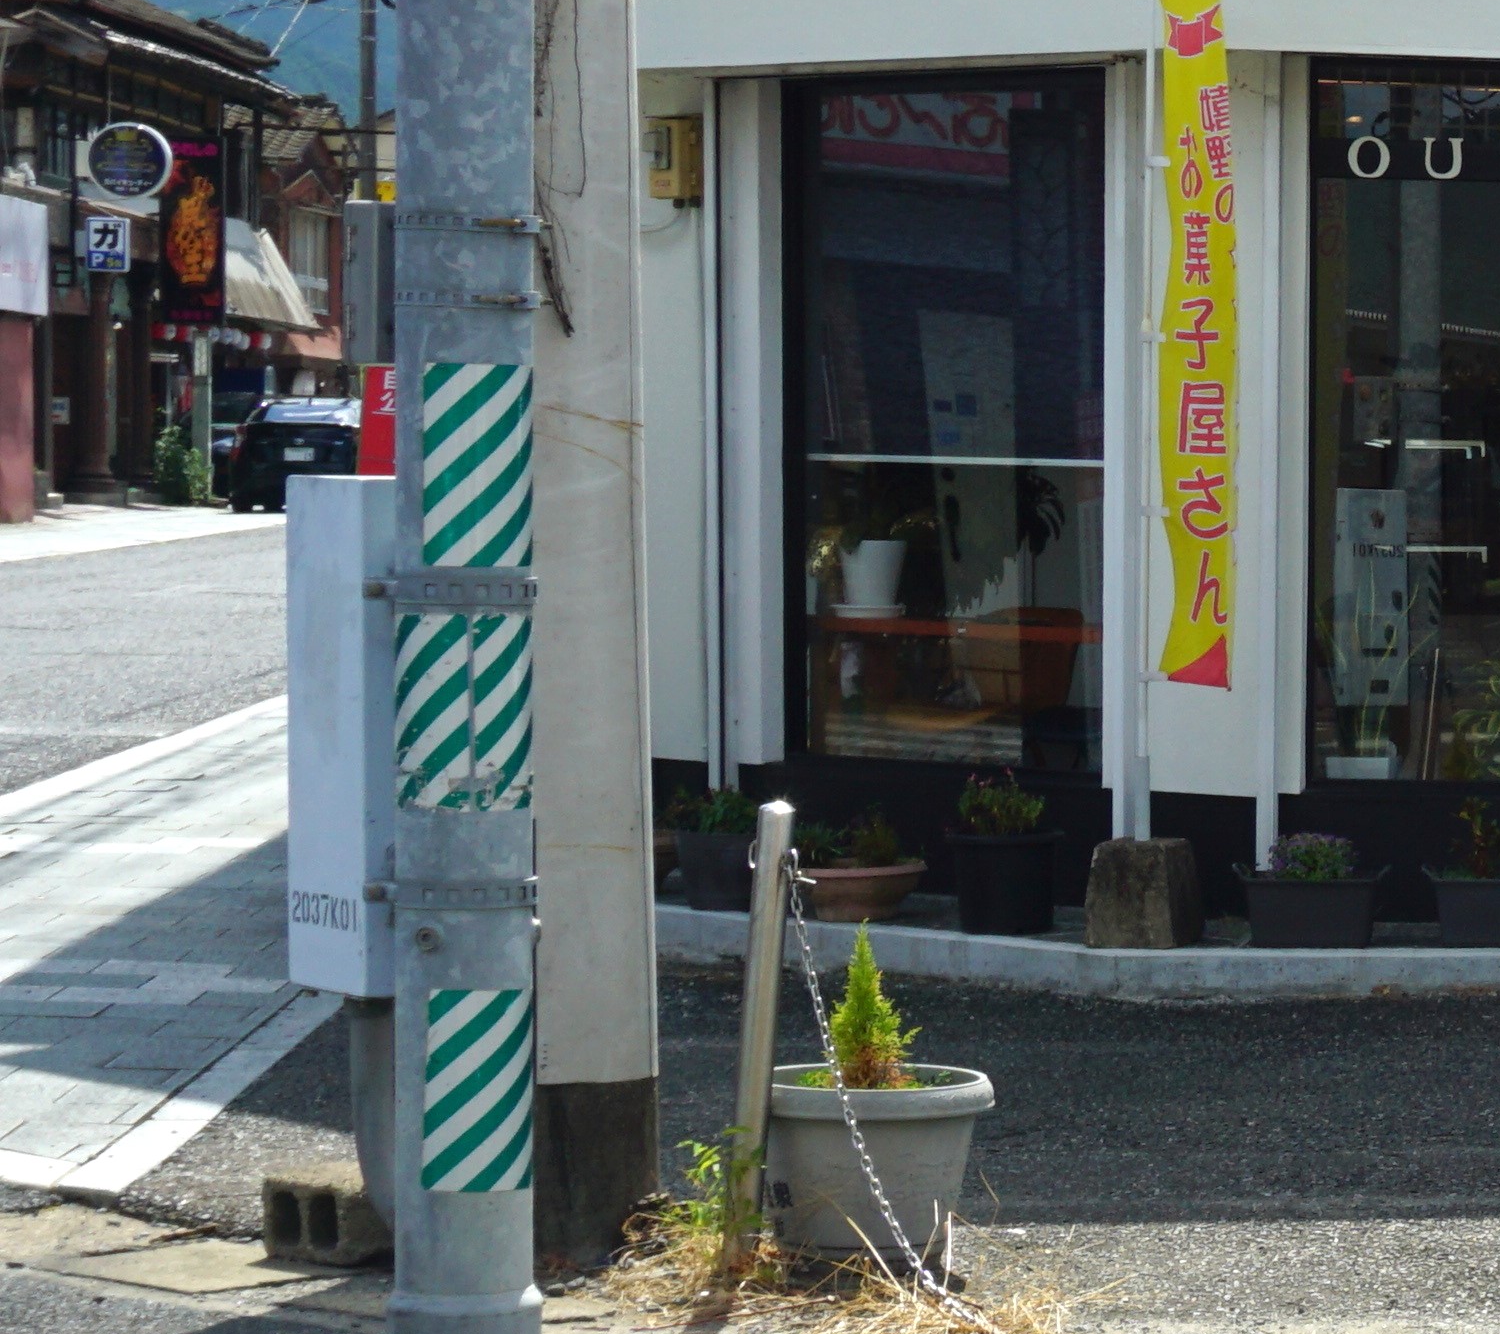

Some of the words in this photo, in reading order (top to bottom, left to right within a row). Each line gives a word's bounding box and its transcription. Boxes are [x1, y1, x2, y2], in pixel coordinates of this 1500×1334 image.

[1175, 126, 1229, 625] お菓子屋さん
[293, 891, 357, 932] 2037K01
